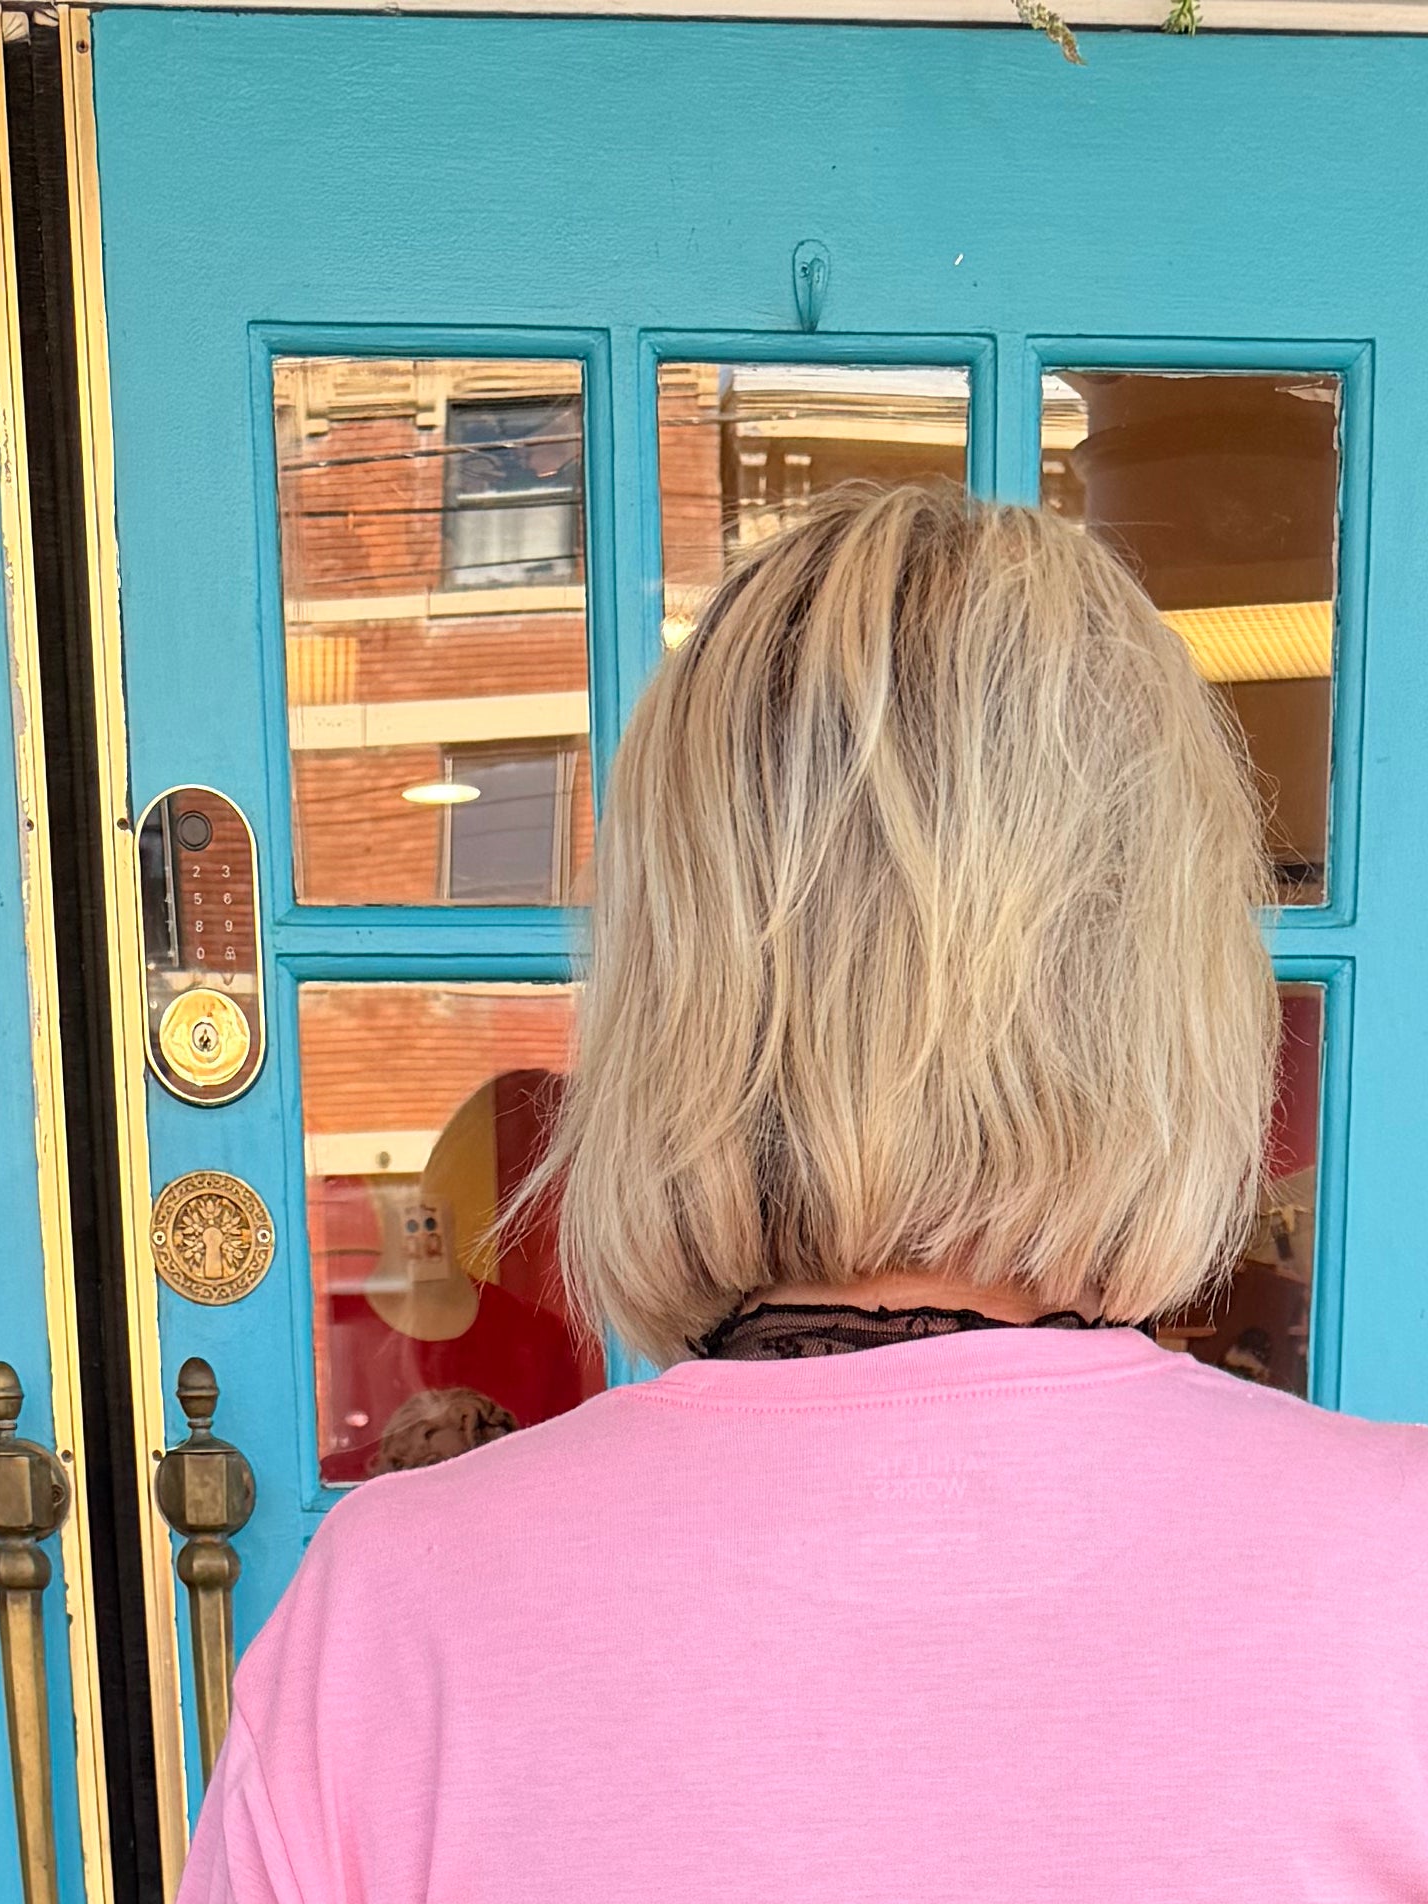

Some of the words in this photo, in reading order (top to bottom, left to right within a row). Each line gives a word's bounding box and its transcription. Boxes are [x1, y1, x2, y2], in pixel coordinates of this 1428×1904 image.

[192, 866, 201, 878] 2
[222, 866, 231, 878] 3
[194, 893, 203, 905] 5
[223, 893, 232, 905] 6
[195, 920, 204, 932] 8
[225, 920, 233, 932] 9
[196, 948, 205, 960] 0
